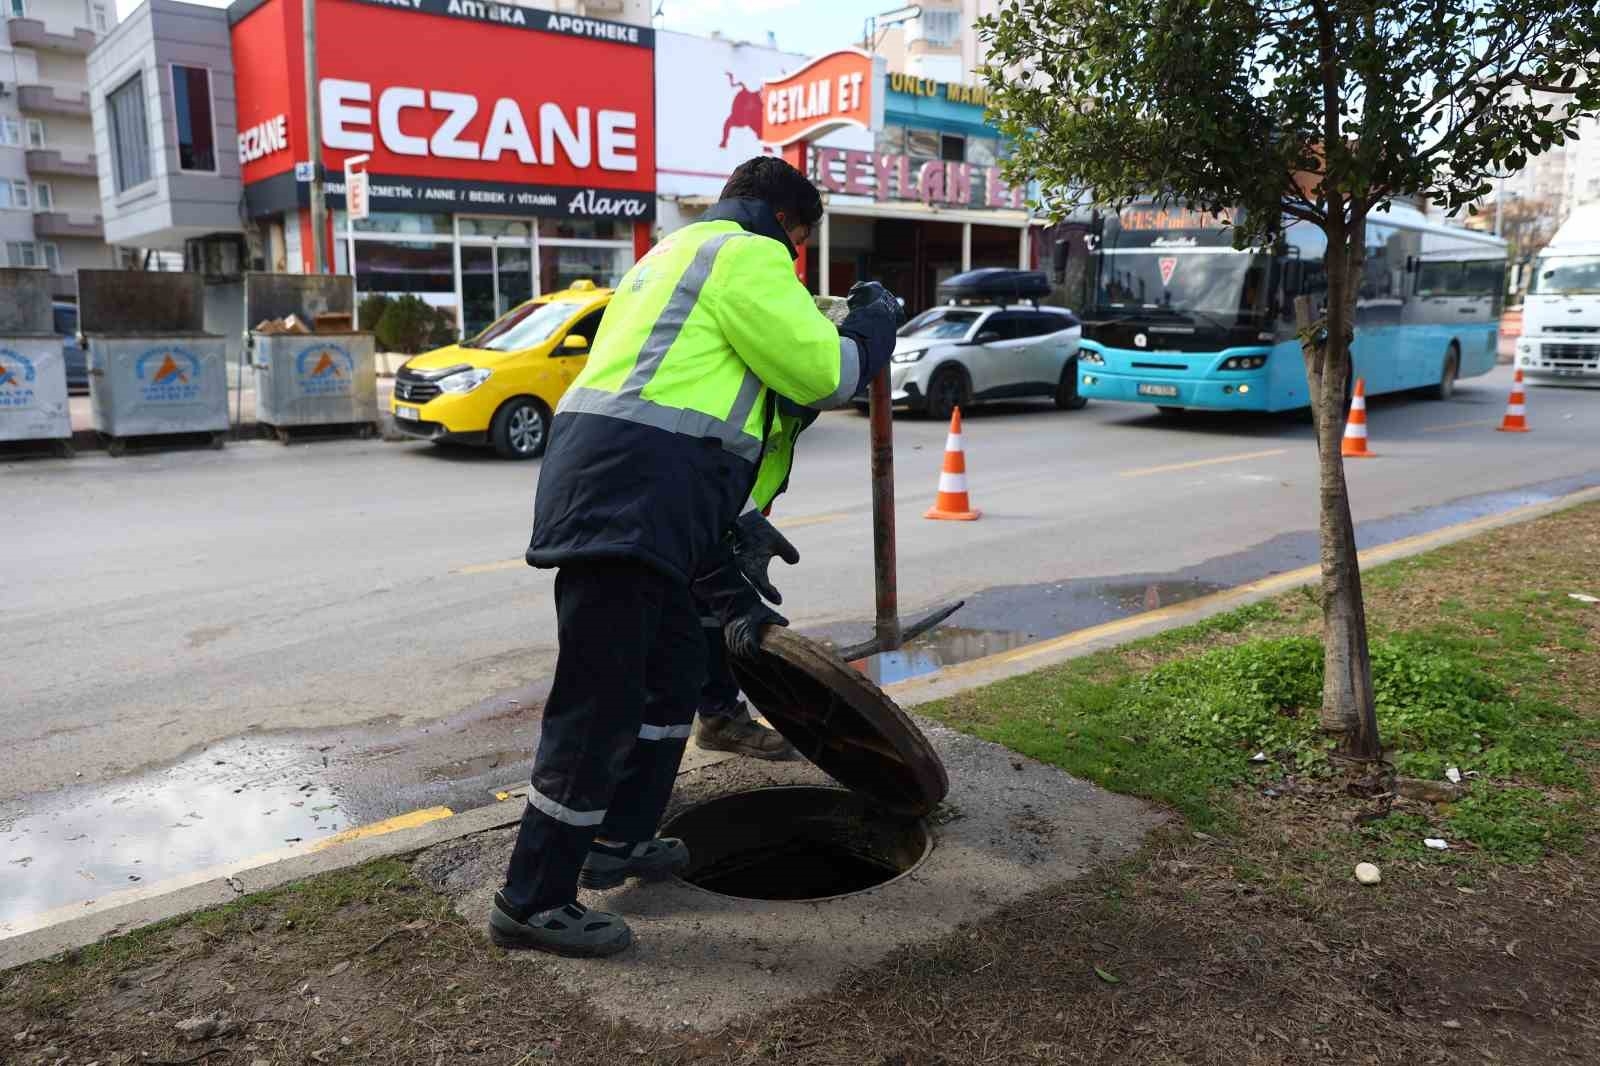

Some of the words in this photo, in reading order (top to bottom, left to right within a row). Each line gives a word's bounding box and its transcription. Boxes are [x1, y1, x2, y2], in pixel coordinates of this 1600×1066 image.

[547, 14, 639, 43] APOTHEKE
[767, 80, 830, 125] CEYLAN
[838, 71, 863, 112] ET
[238, 114, 288, 165] ECZANE
[319, 78, 638, 171] ECZANE
[425, 189, 456, 201] ANNE
[469, 190, 506, 203] BEBEK
[817, 148, 972, 204] CEYLAN
[568, 189, 647, 216] Alara
